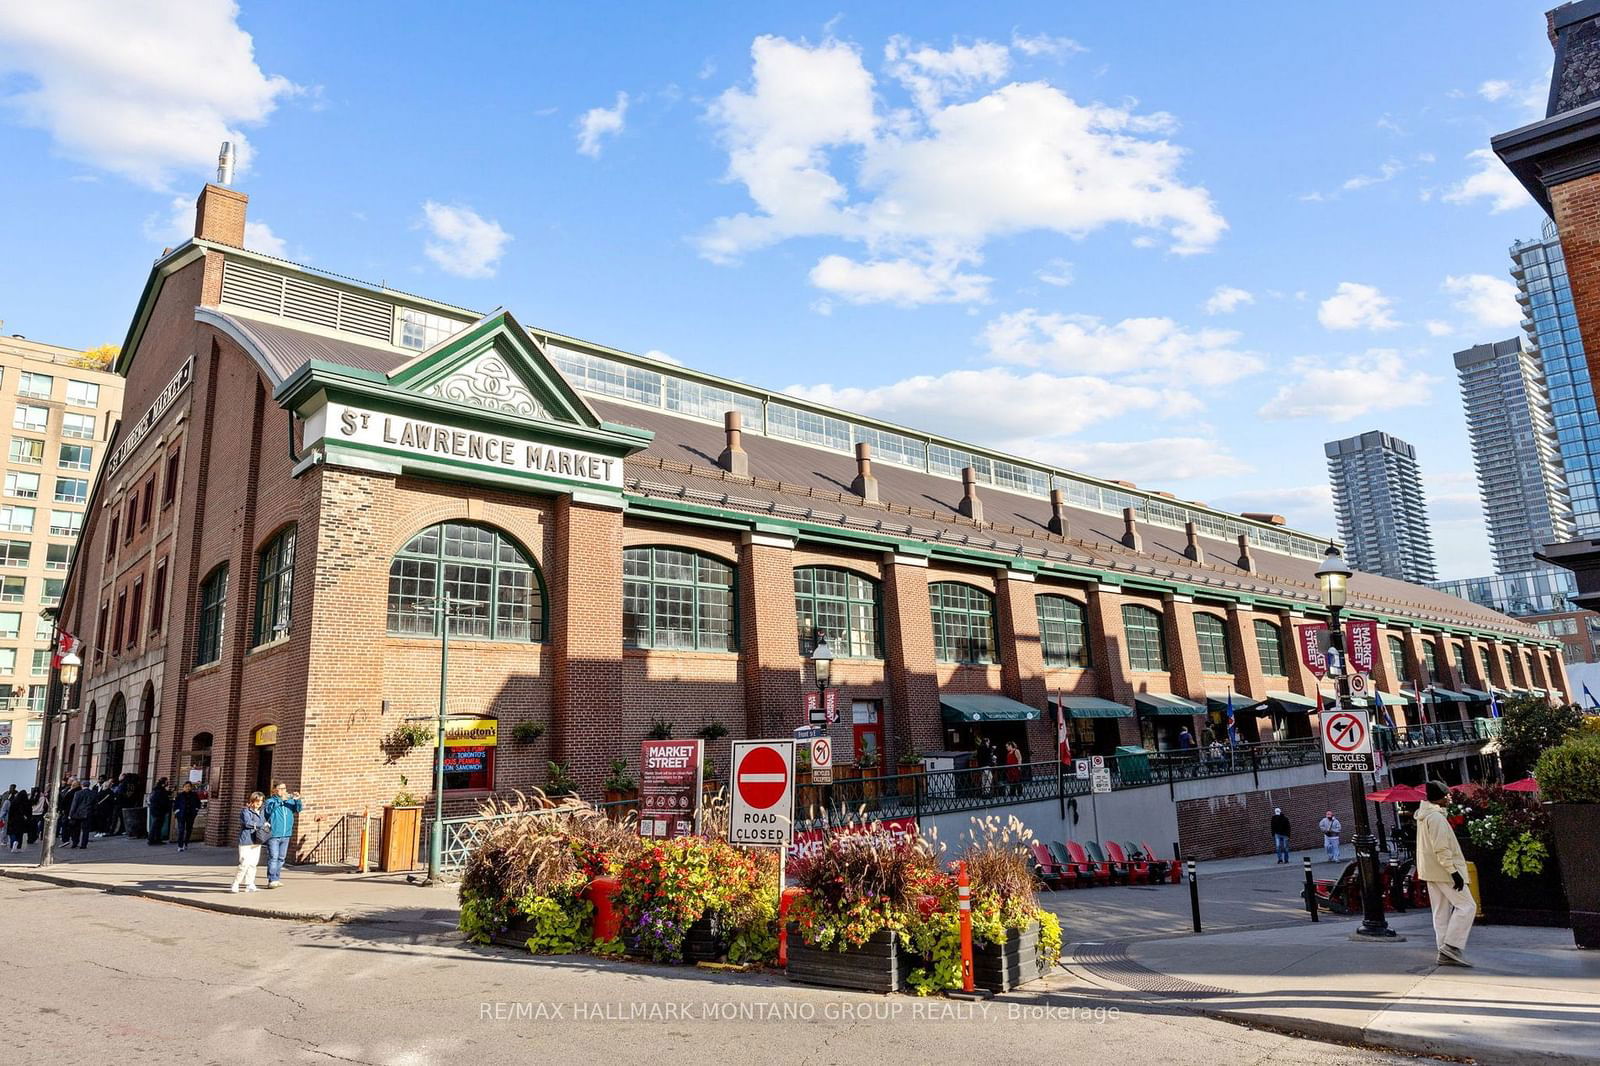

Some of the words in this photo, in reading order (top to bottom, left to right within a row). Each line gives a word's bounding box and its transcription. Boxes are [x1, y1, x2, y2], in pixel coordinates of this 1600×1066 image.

[383, 418, 516, 465] LAWRENCE
[526, 445, 614, 481] MARKET
[1305, 630, 1318, 667] STREET
[1353, 627, 1364, 666] STREET
[1361, 627, 1372, 671] MARKET
[445, 727, 496, 740] ddington's
[649, 746, 694, 757] MARKET
[648, 757, 689, 768] STREET
[1331, 754, 1366, 762] BICYCLES
[1332, 763, 1368, 771] EXCEPTED
[744, 813, 777, 824] ROAD
[736, 829, 784, 841] CLOSED
